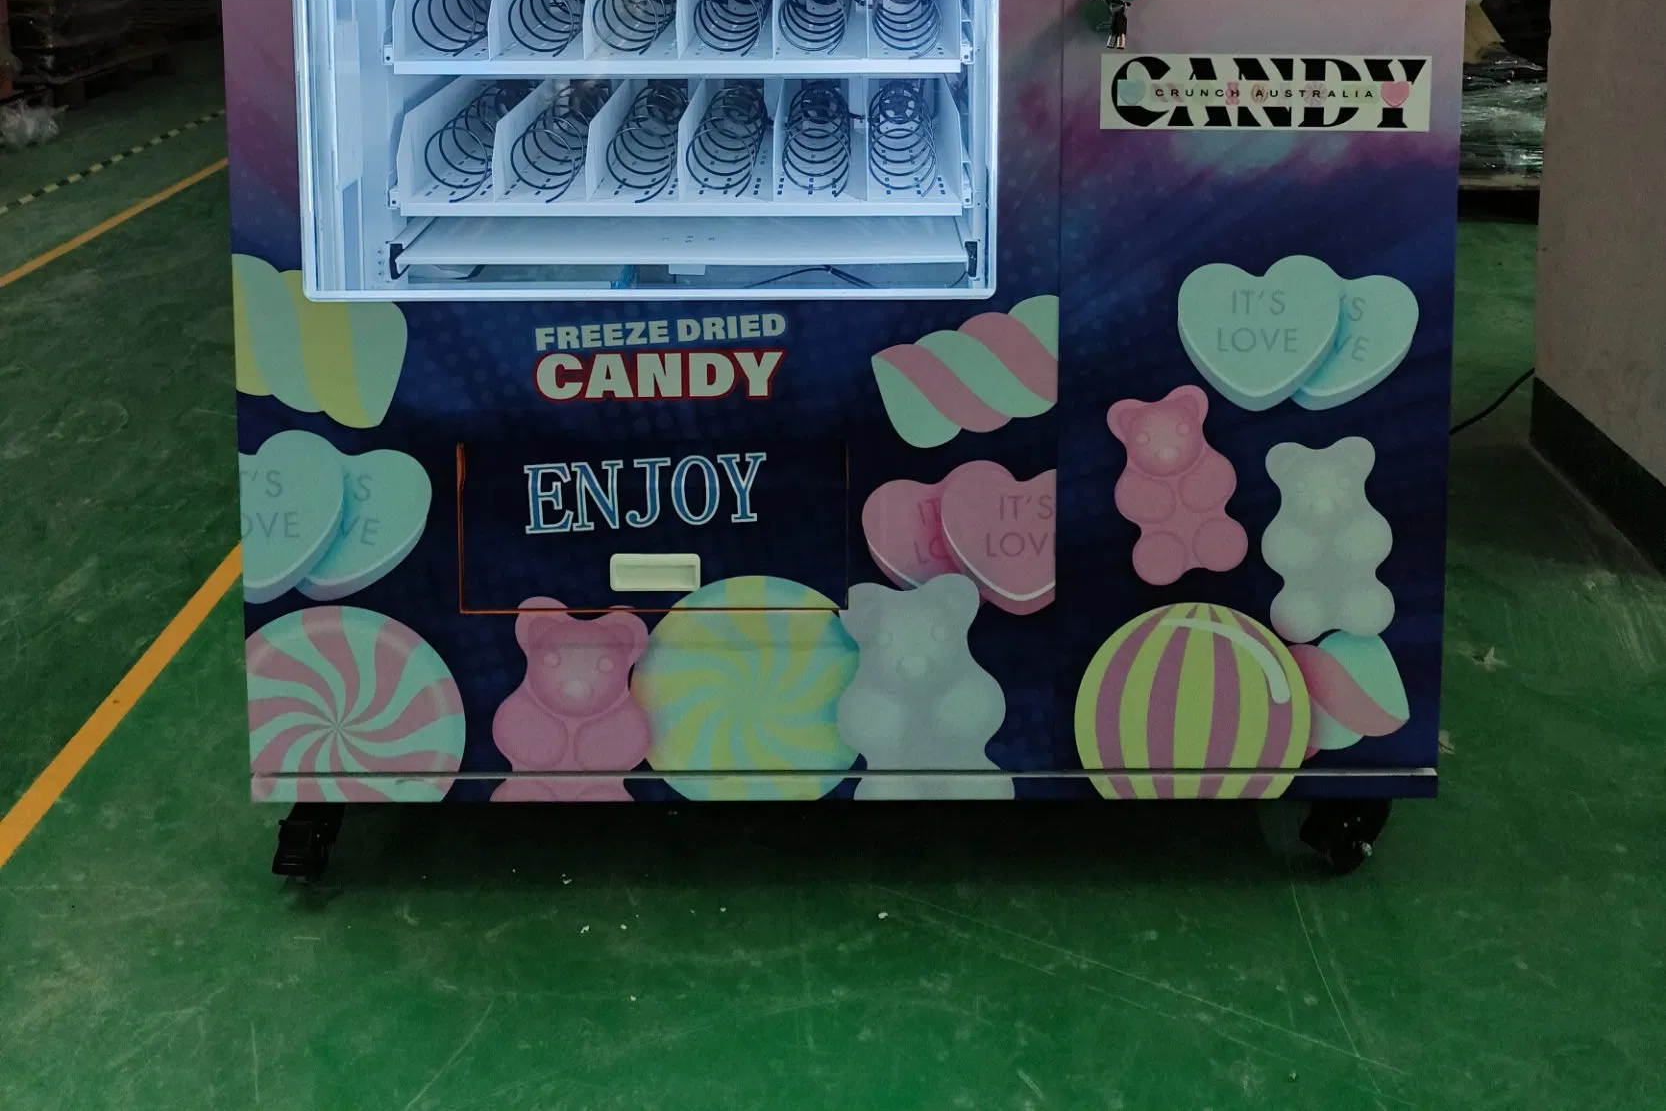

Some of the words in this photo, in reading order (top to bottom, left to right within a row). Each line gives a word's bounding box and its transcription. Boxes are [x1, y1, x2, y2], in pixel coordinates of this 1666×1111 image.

[1111, 56, 1427, 128] CANDY
[1155, 88, 1240, 98] CRUNCH
[1255, 89, 1374, 98] AUSTRALIA
[1231, 289, 1286, 316] IT'S
[534, 320, 670, 351] FREEZE
[677, 313, 786, 342] DRIED
[1216, 327, 1299, 353] LOVE
[535, 350, 784, 400] CANDY
[523, 452, 767, 534] ENJOY
[1000, 494, 1054, 521] IT'S
